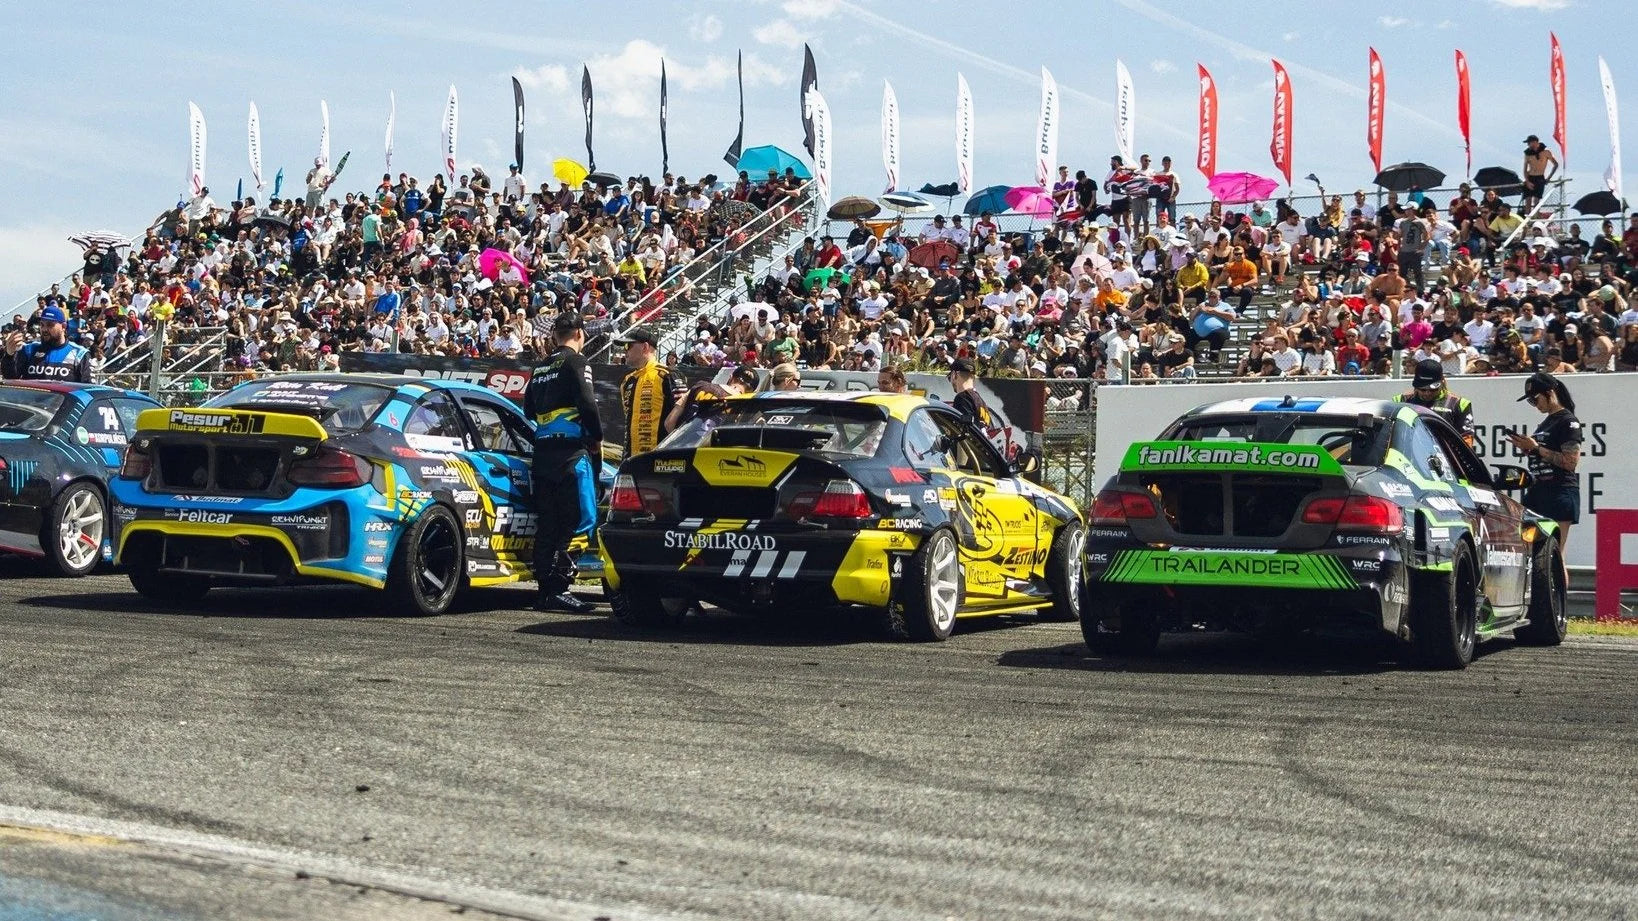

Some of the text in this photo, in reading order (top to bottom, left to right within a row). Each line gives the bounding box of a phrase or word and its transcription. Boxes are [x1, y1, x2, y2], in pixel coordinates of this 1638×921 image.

[487, 373, 530, 395] SP
[170, 410, 231, 427] Pesur
[170, 423, 228, 433] Motorsport
[179, 508, 233, 524] Feltcar
[271, 514, 329, 524] REHVIPUNKT
[363, 521, 394, 532] HRX
[1091, 529, 1128, 537] FERRAIN
[1346, 536, 1390, 545] FERRAIN
[1086, 553, 1108, 561] WRC
[1150, 556, 1299, 576] TRAILANDER
[1353, 560, 1380, 569] WRC
